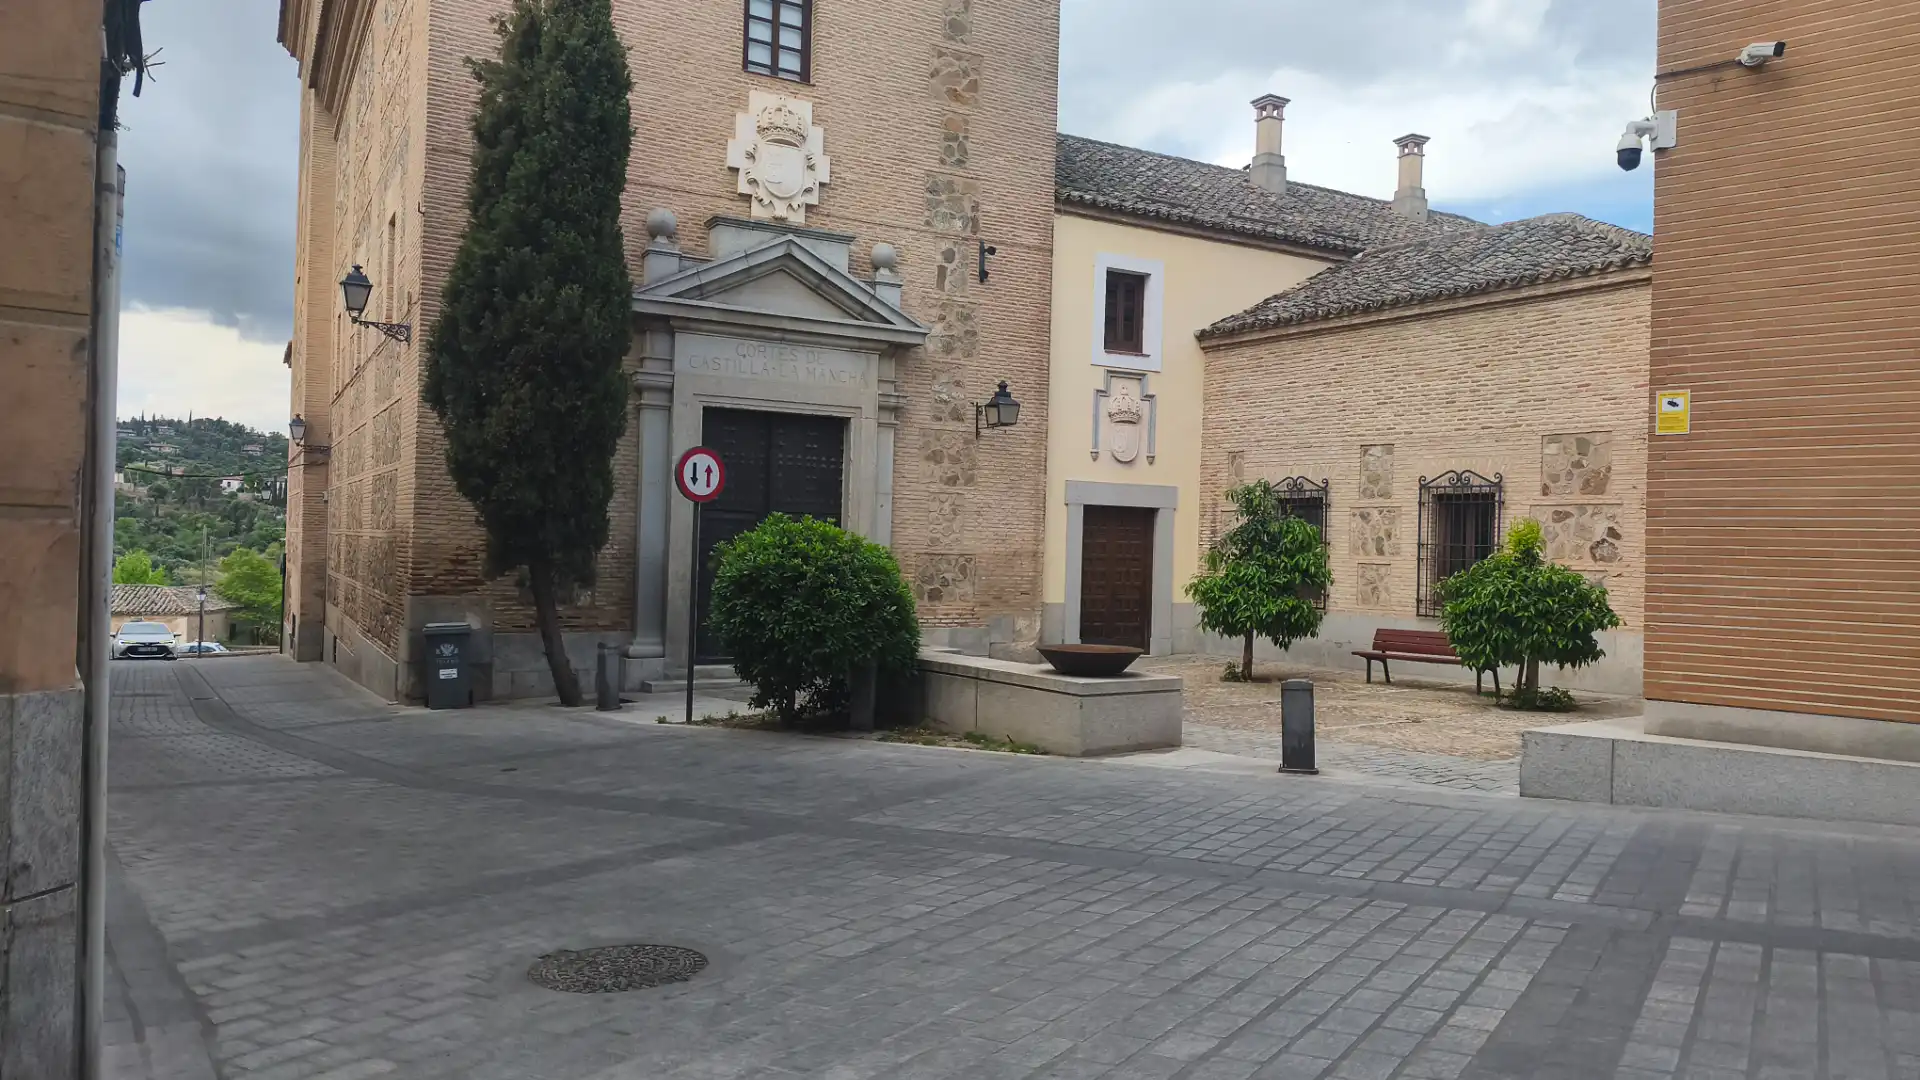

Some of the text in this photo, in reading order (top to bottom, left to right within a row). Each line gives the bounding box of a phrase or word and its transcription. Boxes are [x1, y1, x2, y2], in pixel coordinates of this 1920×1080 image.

[735, 342, 826, 365] CORTES DE
[805, 367, 868, 387] MANCHA
